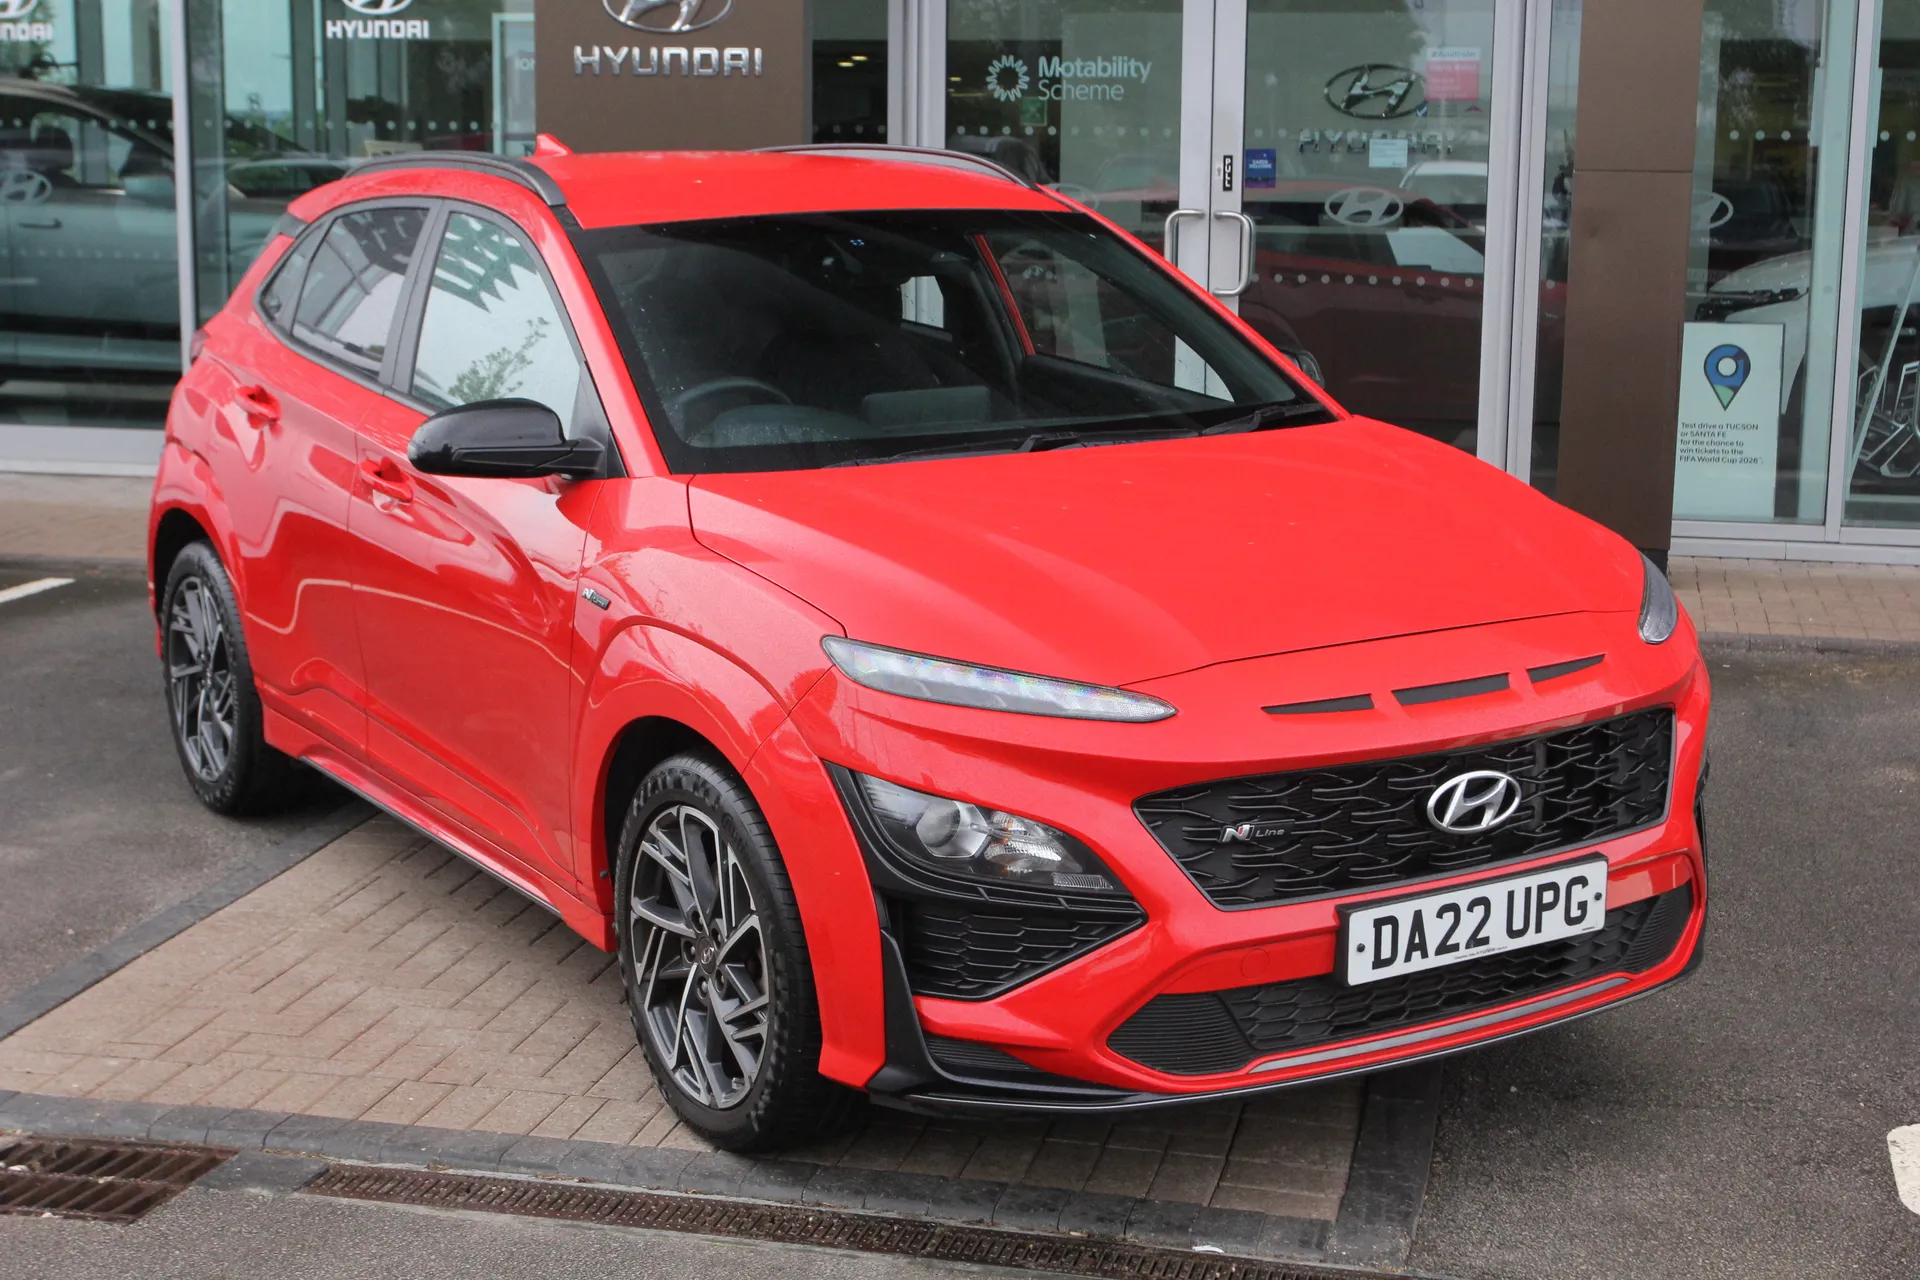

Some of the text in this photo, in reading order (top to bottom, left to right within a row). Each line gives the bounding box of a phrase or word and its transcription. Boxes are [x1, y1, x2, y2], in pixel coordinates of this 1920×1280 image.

[326, 20, 429, 39] HYUNDAI
[573, 45, 762, 76] HYUNDAI
[1038, 55, 1152, 84] Motability
[1038, 79, 1125, 100] Scheme
[1698, 422, 1717, 430] drive
[1725, 423, 1759, 431] TUCSON
[1680, 438, 1691, 446] for
[1706, 439, 1735, 447] chance
[1721, 456, 1738, 464] Cup
[1372, 875, 1590, 970] DA22 UPG
